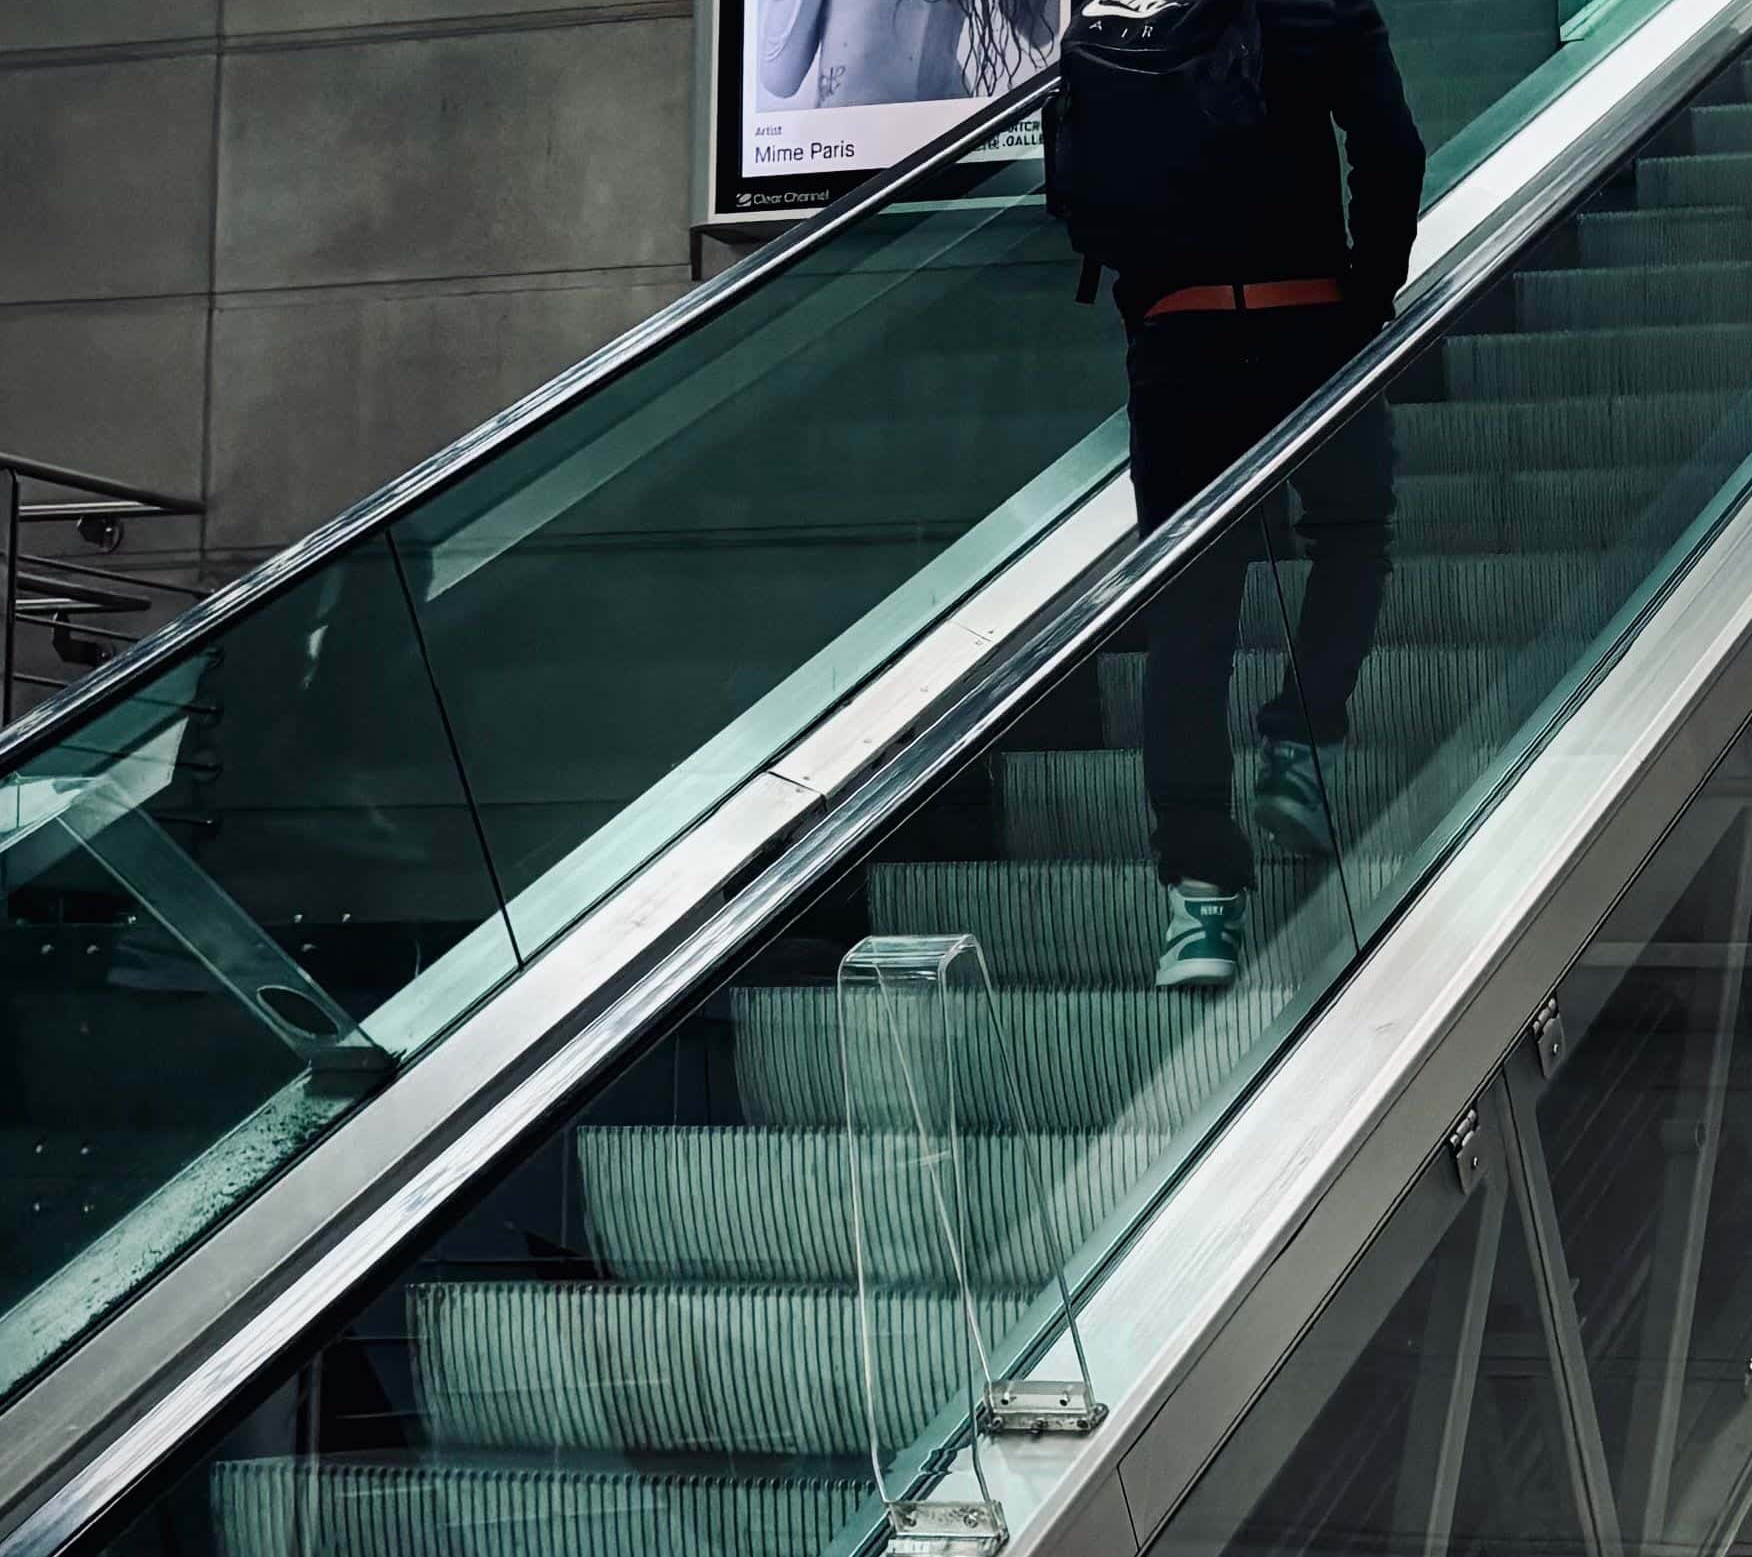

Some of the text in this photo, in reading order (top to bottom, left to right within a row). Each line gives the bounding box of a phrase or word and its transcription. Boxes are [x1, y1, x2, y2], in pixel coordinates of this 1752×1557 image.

[1089, 20, 1154, 38] AIR
[755, 140, 855, 164] Mime Paris
